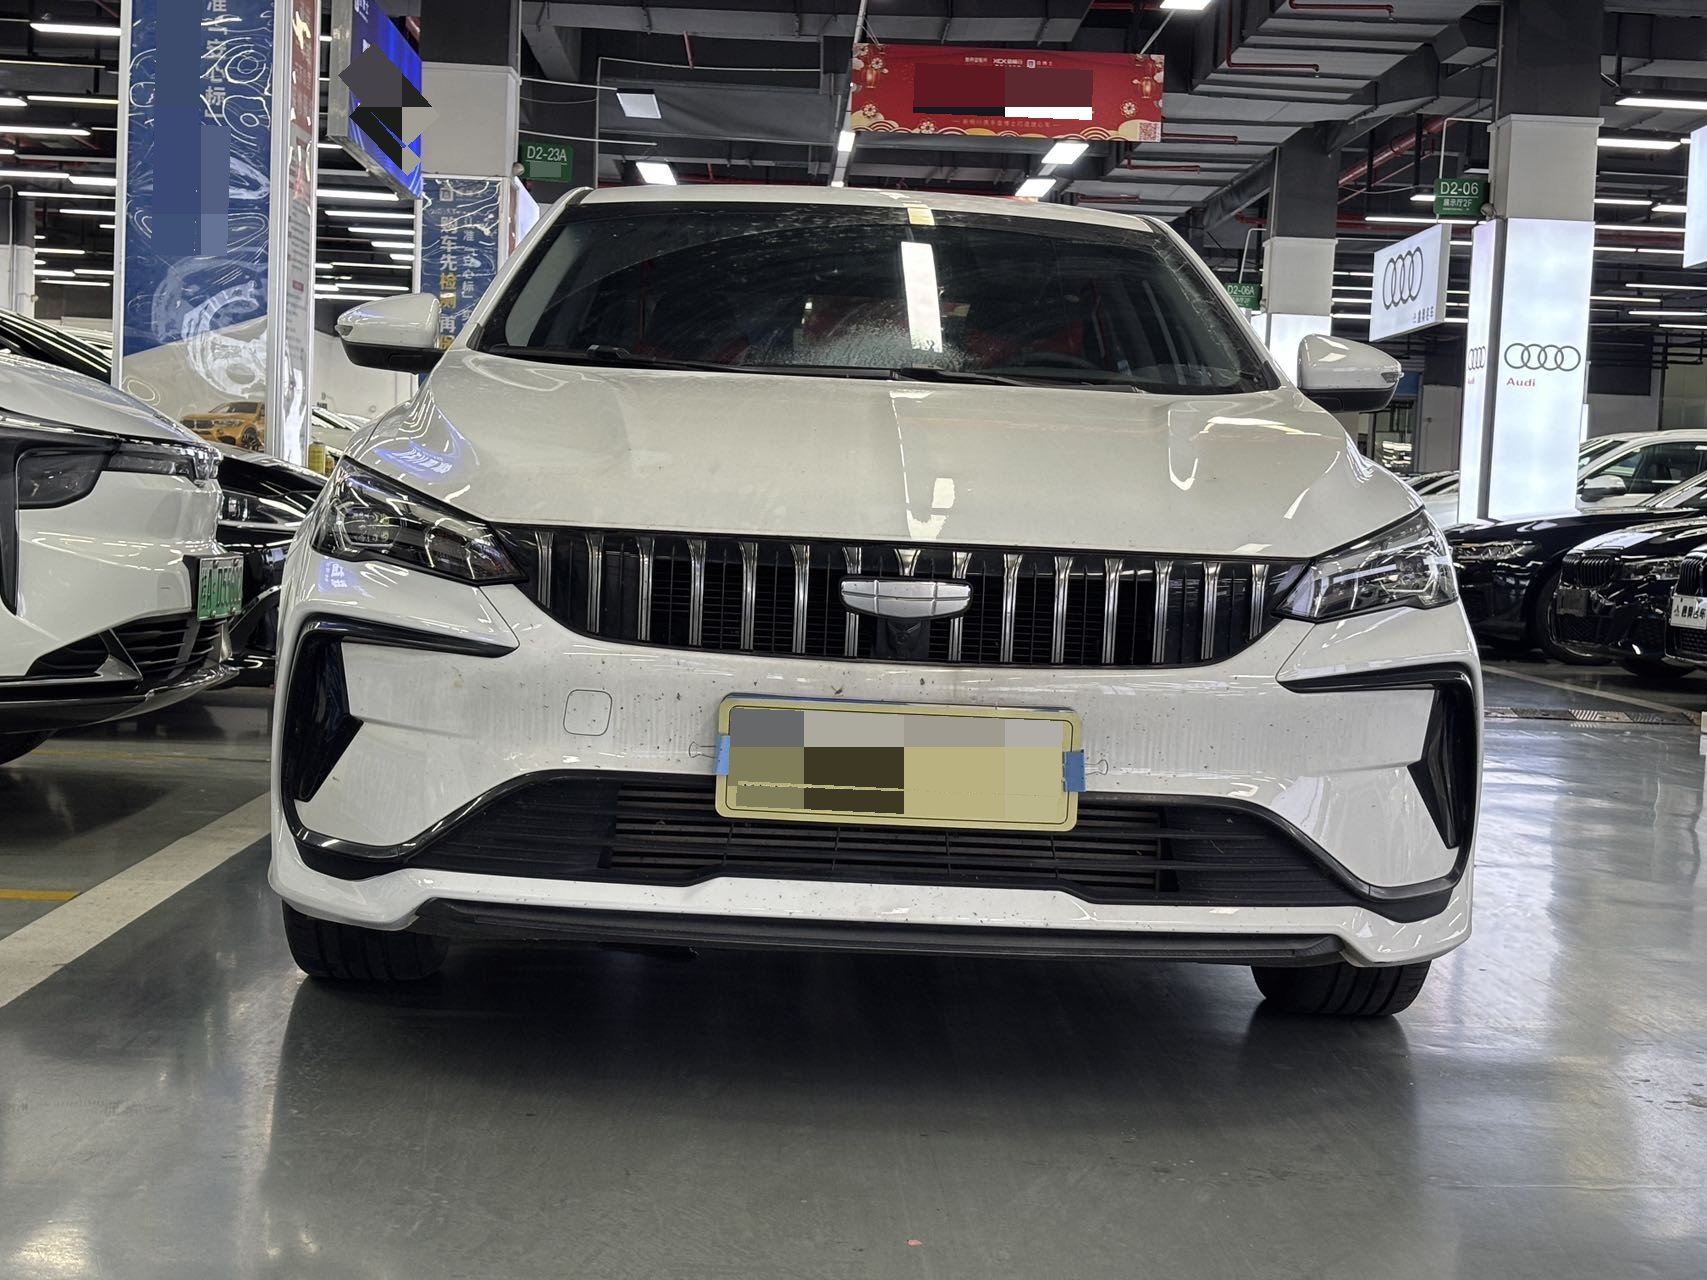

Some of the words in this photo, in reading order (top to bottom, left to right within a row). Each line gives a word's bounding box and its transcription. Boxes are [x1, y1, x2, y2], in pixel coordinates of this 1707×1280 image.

[526, 145, 568, 162] D2-23A
[1440, 181, 1479, 196] D2-06
[1227, 284, 1255, 296] D2-06A
[1506, 377, 1536, 387] Audi
